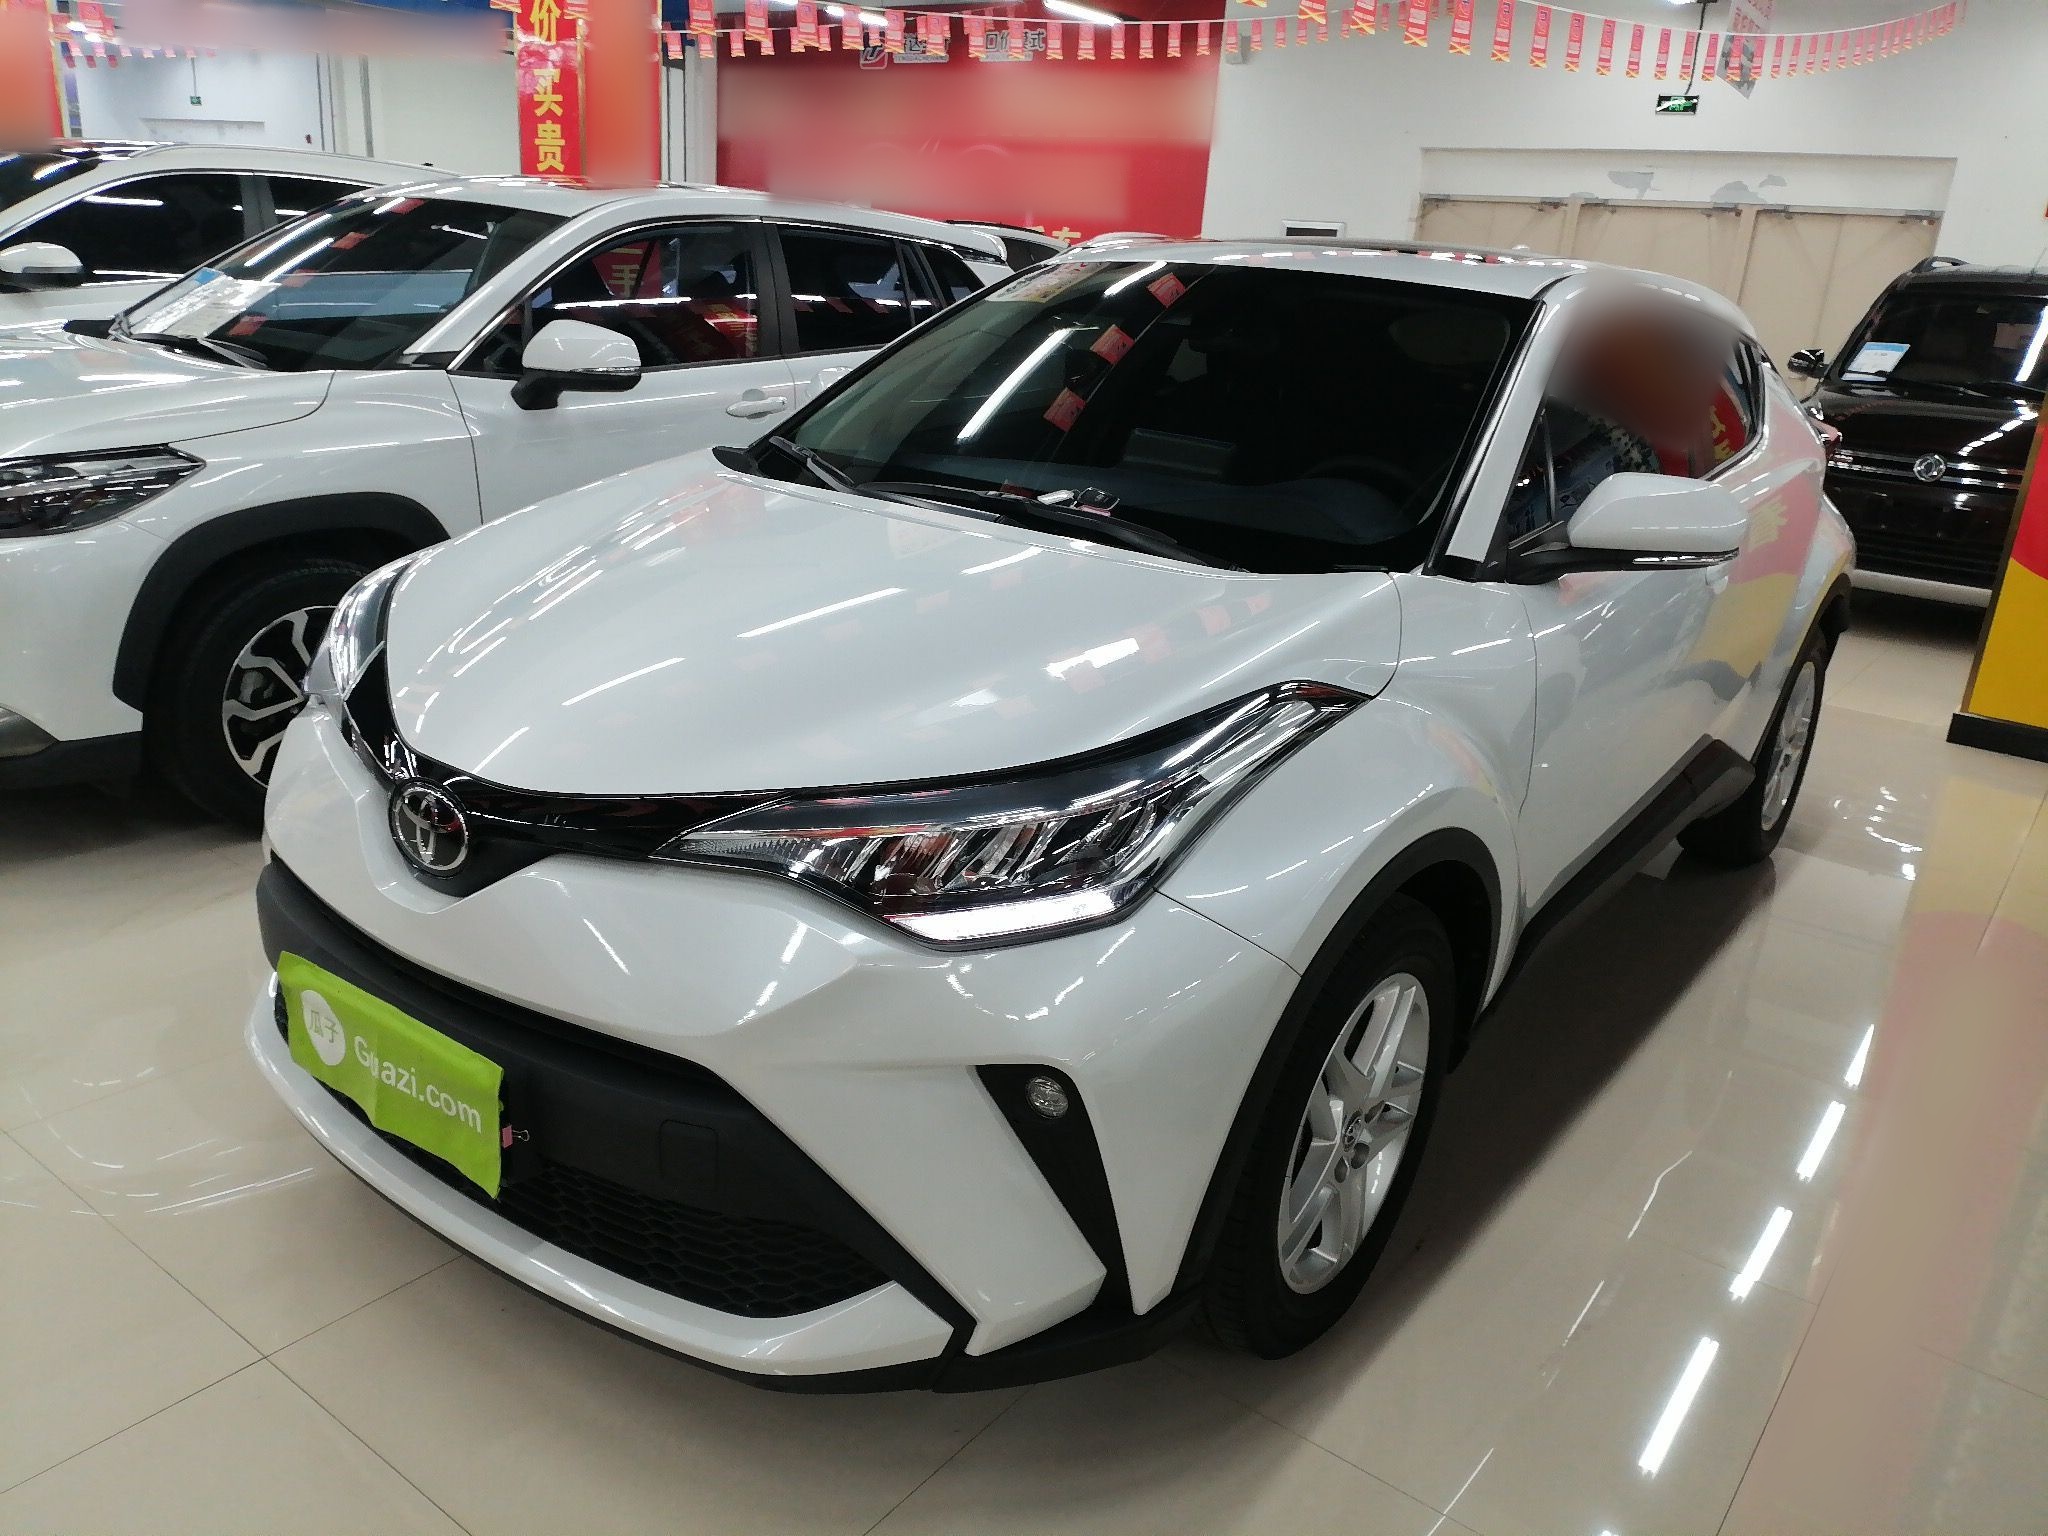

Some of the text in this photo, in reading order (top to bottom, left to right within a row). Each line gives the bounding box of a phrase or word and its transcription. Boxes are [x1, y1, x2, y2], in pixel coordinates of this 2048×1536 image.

[534, 69, 565, 172] 买贵
[309, 1010, 339, 1043] 瓜子
[354, 1036, 482, 1134] Guazi.com
